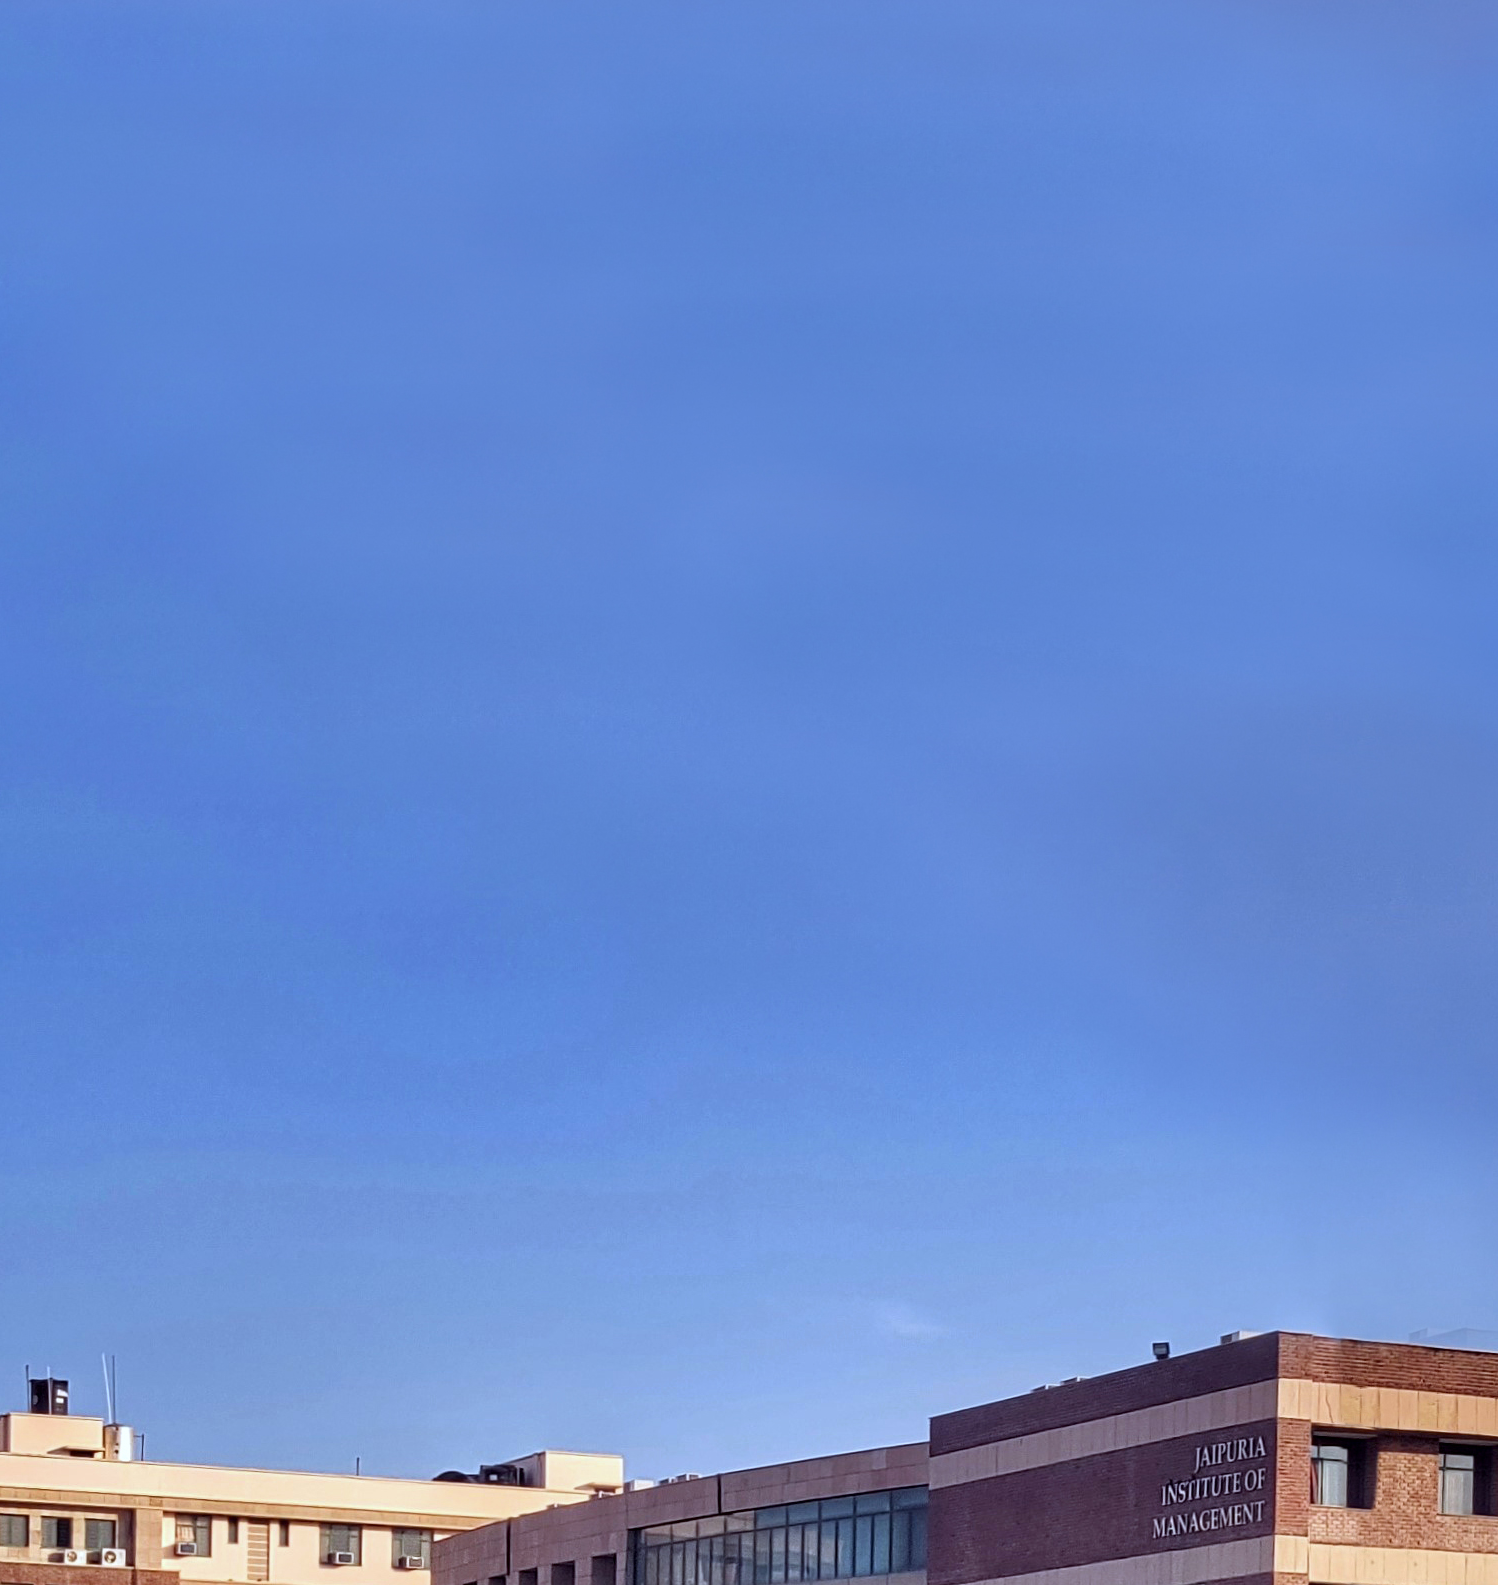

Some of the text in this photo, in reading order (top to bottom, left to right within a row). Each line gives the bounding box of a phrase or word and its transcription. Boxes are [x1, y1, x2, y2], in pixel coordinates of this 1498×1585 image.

[1194, 1436, 1266, 1473] JAIPURIA
[1161, 1468, 1266, 1506] INSTITUTE OF
[1152, 1501, 1265, 1539] MANAGEMENT
